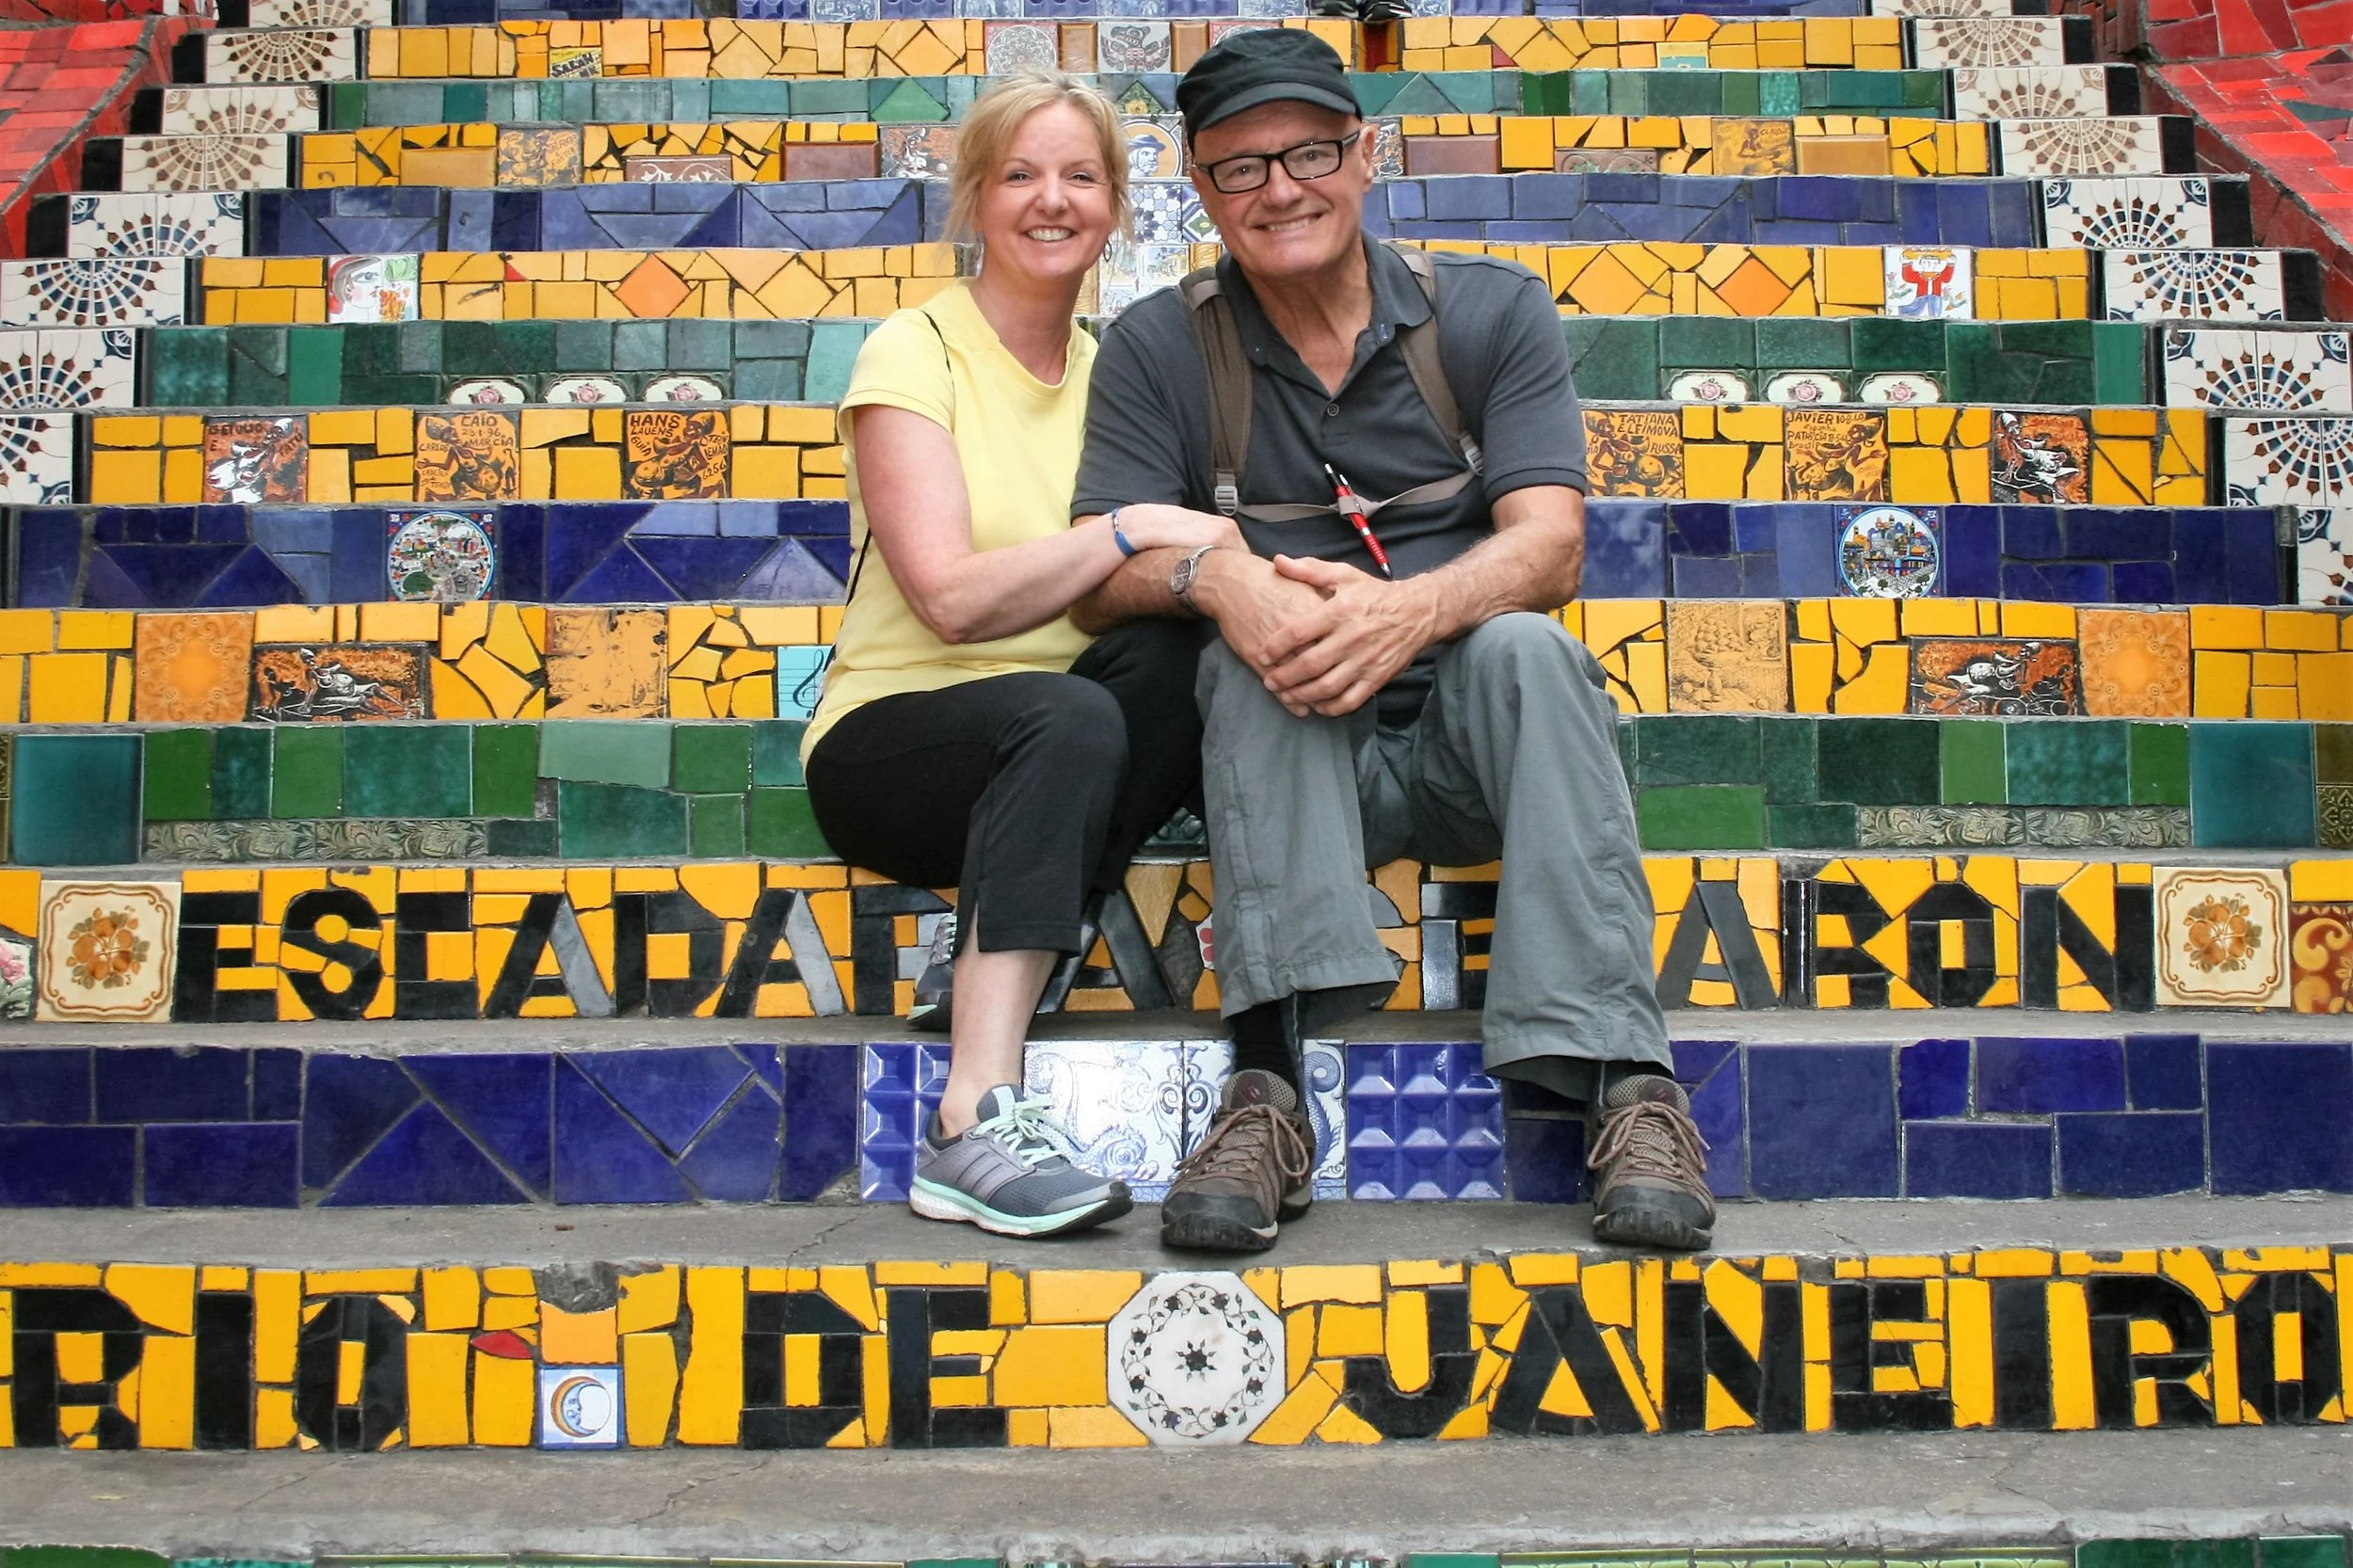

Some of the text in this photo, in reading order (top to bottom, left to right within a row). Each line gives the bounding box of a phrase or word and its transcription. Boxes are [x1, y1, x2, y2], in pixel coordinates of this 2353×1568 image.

[630, 414, 680, 429] HANS
[1618, 413, 1675, 427] TATIANA
[1787, 412, 1833, 424] JAVIER
[1617, 424, 1678, 438] ELFIMOVA
[1649, 442, 1684, 455] RUSSA
[12, 1272, 2343, 1451] RIO DE JANEIRO
